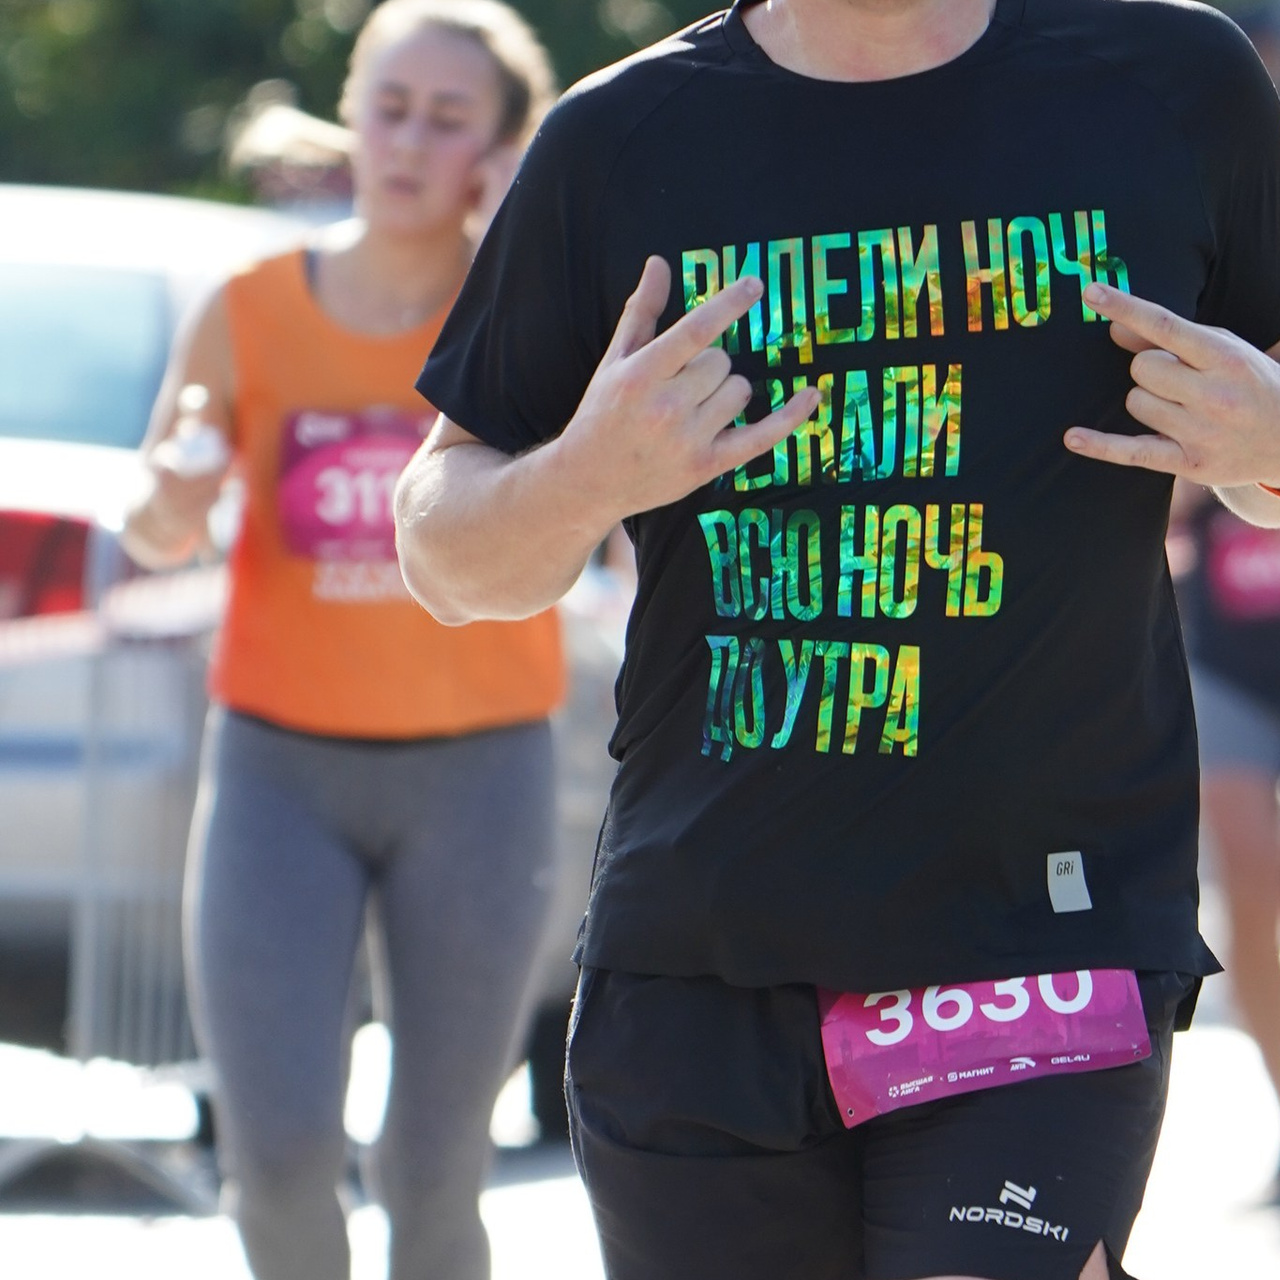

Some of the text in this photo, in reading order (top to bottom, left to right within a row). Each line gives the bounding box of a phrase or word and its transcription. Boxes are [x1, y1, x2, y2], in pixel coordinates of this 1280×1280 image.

[961, 210, 1131, 333] НОЧЬ
[697, 503, 1004, 621] ВСЮ НОЧЬ
[701, 634, 921, 762] ДО УТРА
[863, 970, 1094, 1046] 3630
[900, 1075, 934, 1091] ВЫСШАЯ
[959, 1066, 995, 1080] МАГНИТ
[948, 1205, 1070, 1244] NORDSKI
